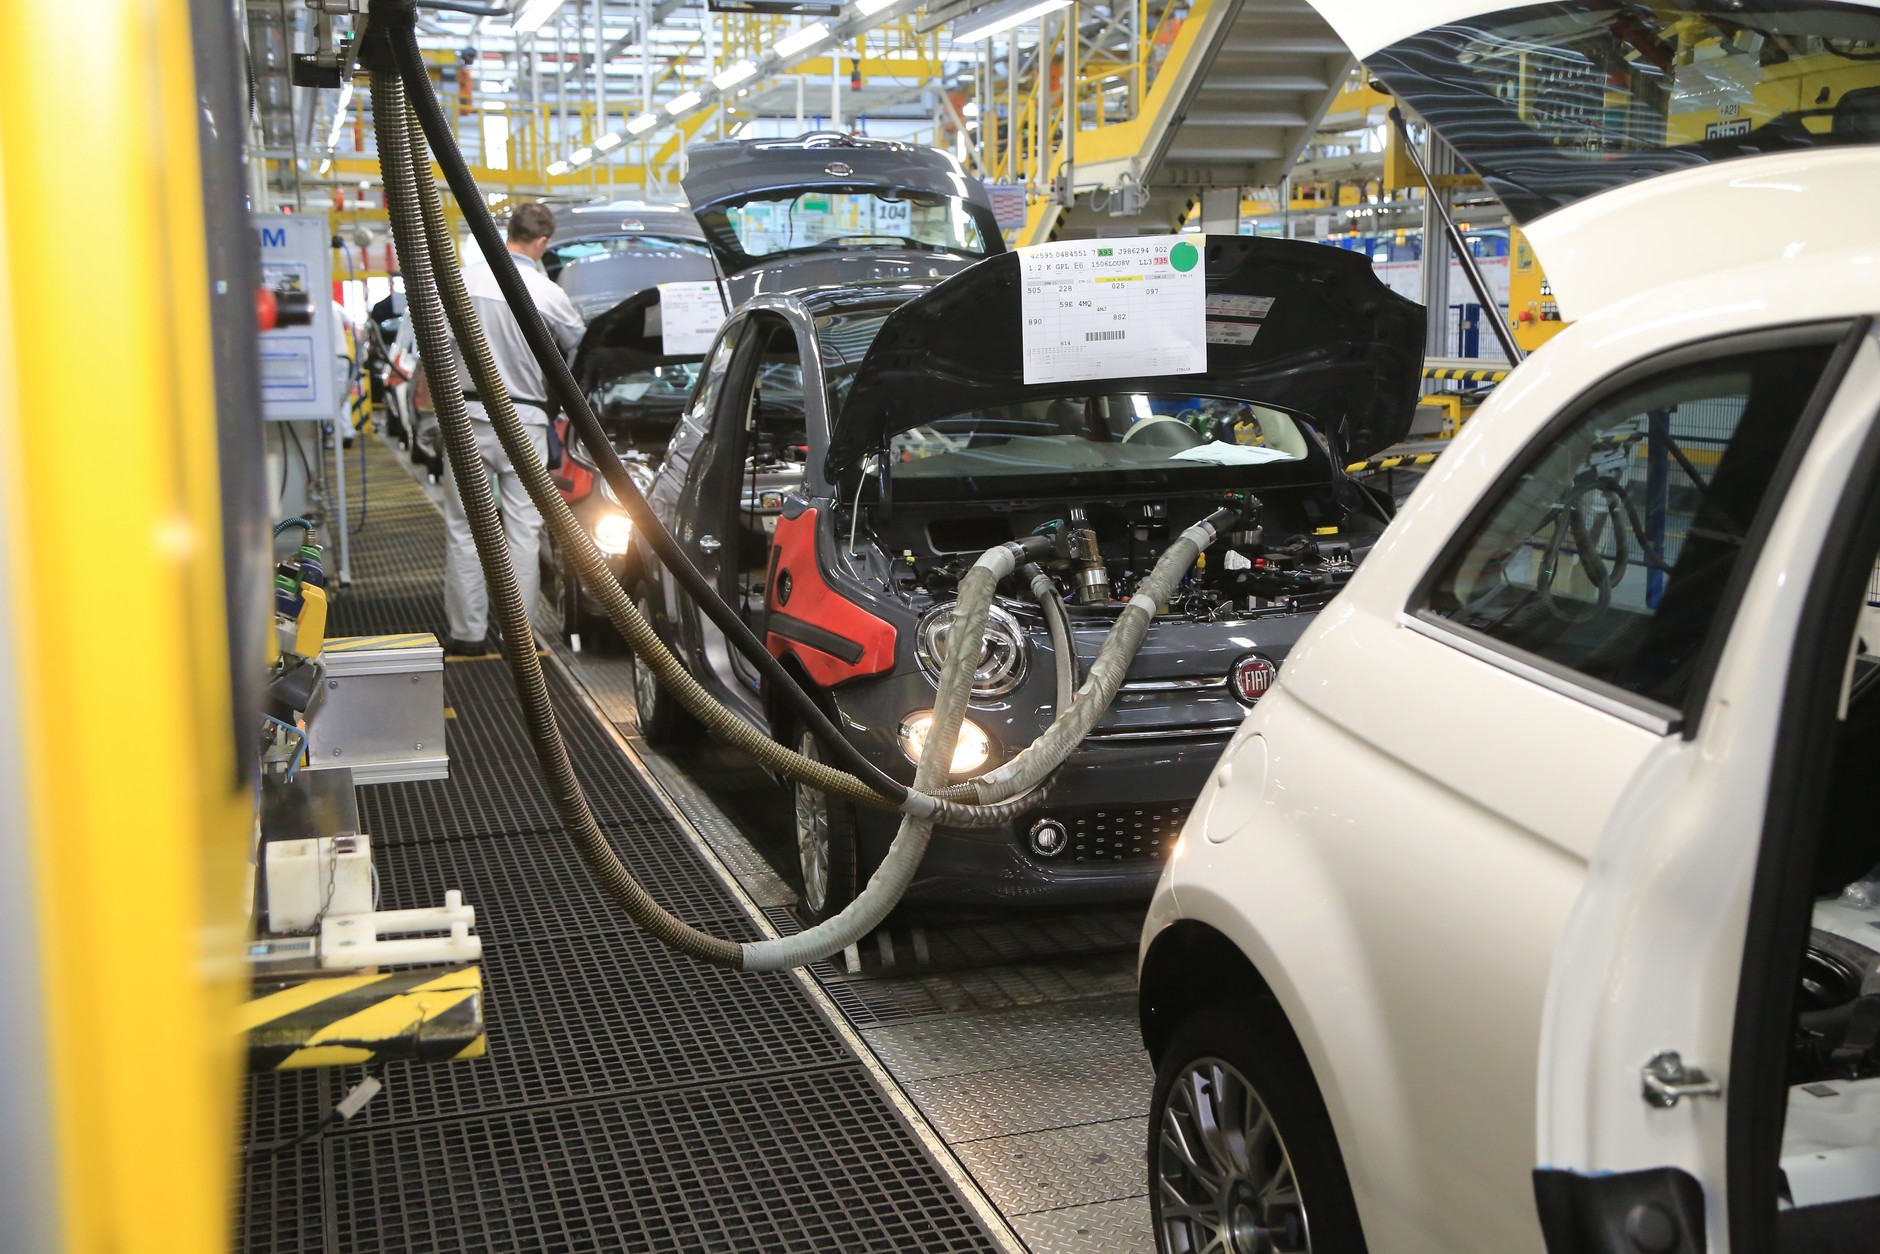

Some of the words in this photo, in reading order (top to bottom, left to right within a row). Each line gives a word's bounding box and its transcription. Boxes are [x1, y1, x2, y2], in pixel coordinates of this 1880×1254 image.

[879, 204, 906, 220] 104
[1031, 251, 1054, 260] 42595
[1055, 250, 1087, 258] 0484551
[1098, 248, 1113, 257] A93
[1117, 247, 1150, 255] J986294
[1028, 264, 1042, 272] 1.2
[1139, 258, 1153, 266] LL3
[1027, 286, 1042, 294] 505
[1111, 282, 1125, 290] 025
[1028, 318, 1043, 326] 890
[1244, 669, 1269, 691] FIAT
